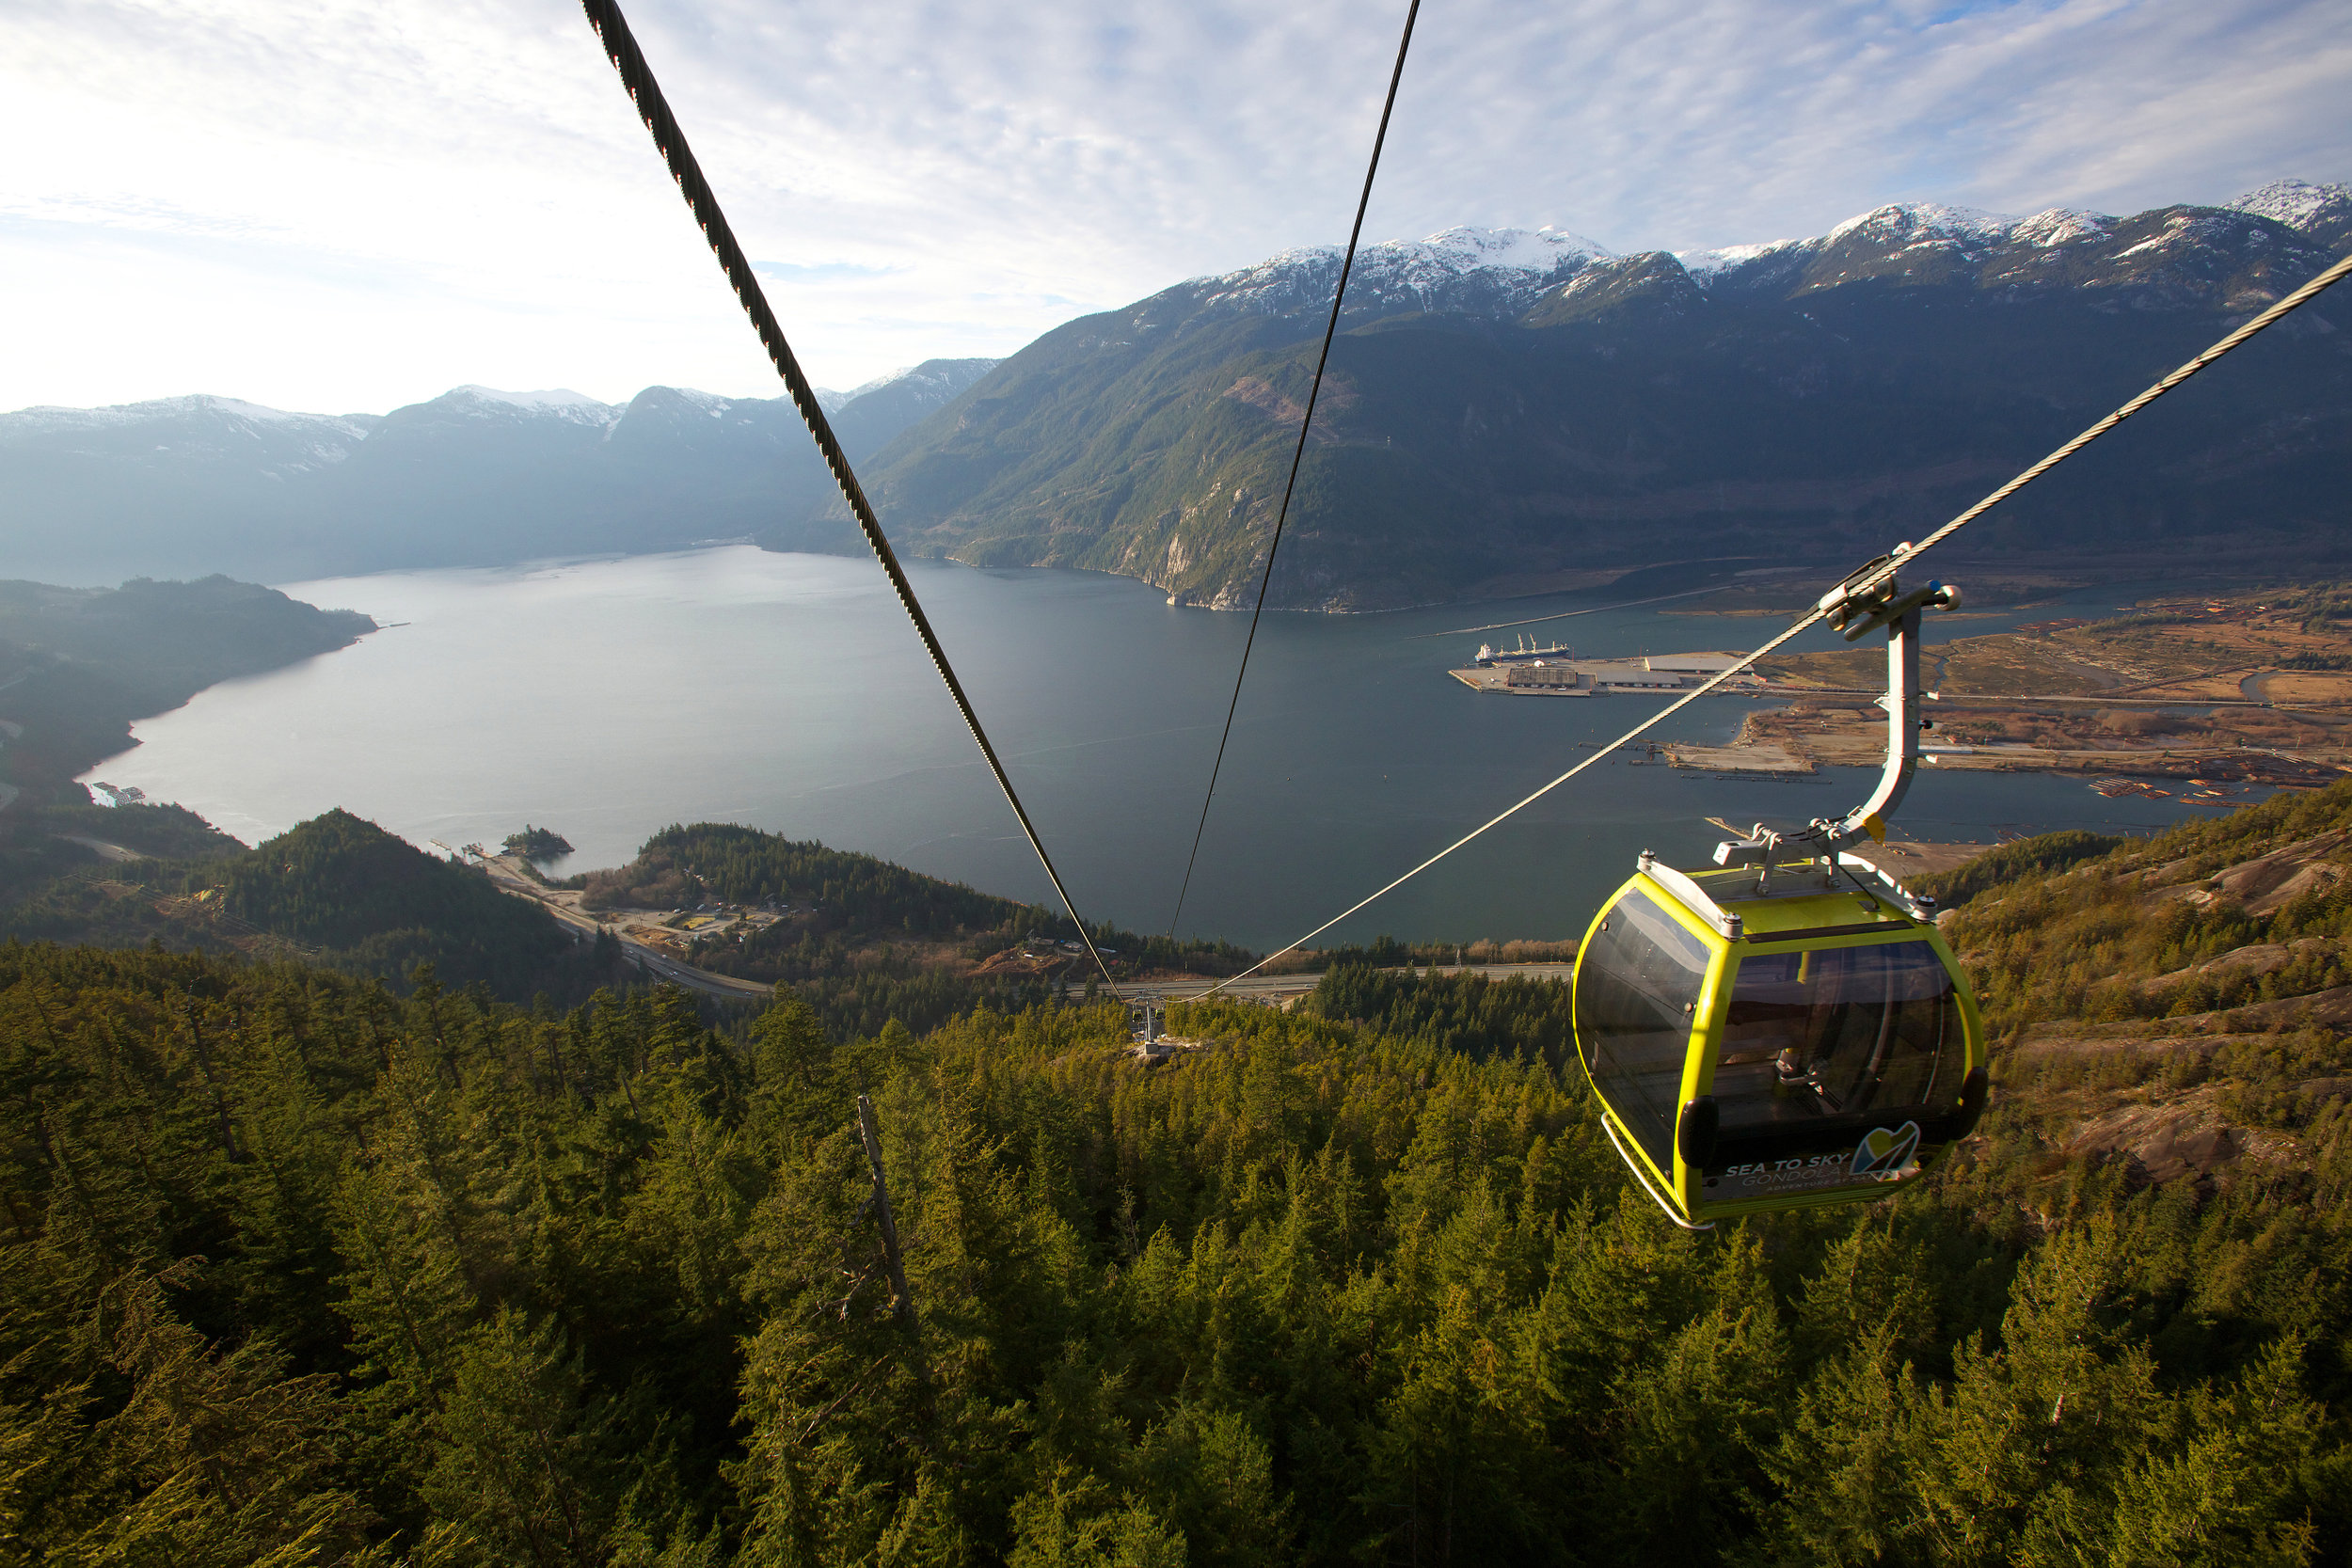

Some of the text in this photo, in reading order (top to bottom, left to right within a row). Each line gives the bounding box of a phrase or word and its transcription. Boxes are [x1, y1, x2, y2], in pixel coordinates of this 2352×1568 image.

[1724, 1152, 1851, 1177] SEA TO SKY
[1741, 1166, 1841, 1187] GONDOLA
